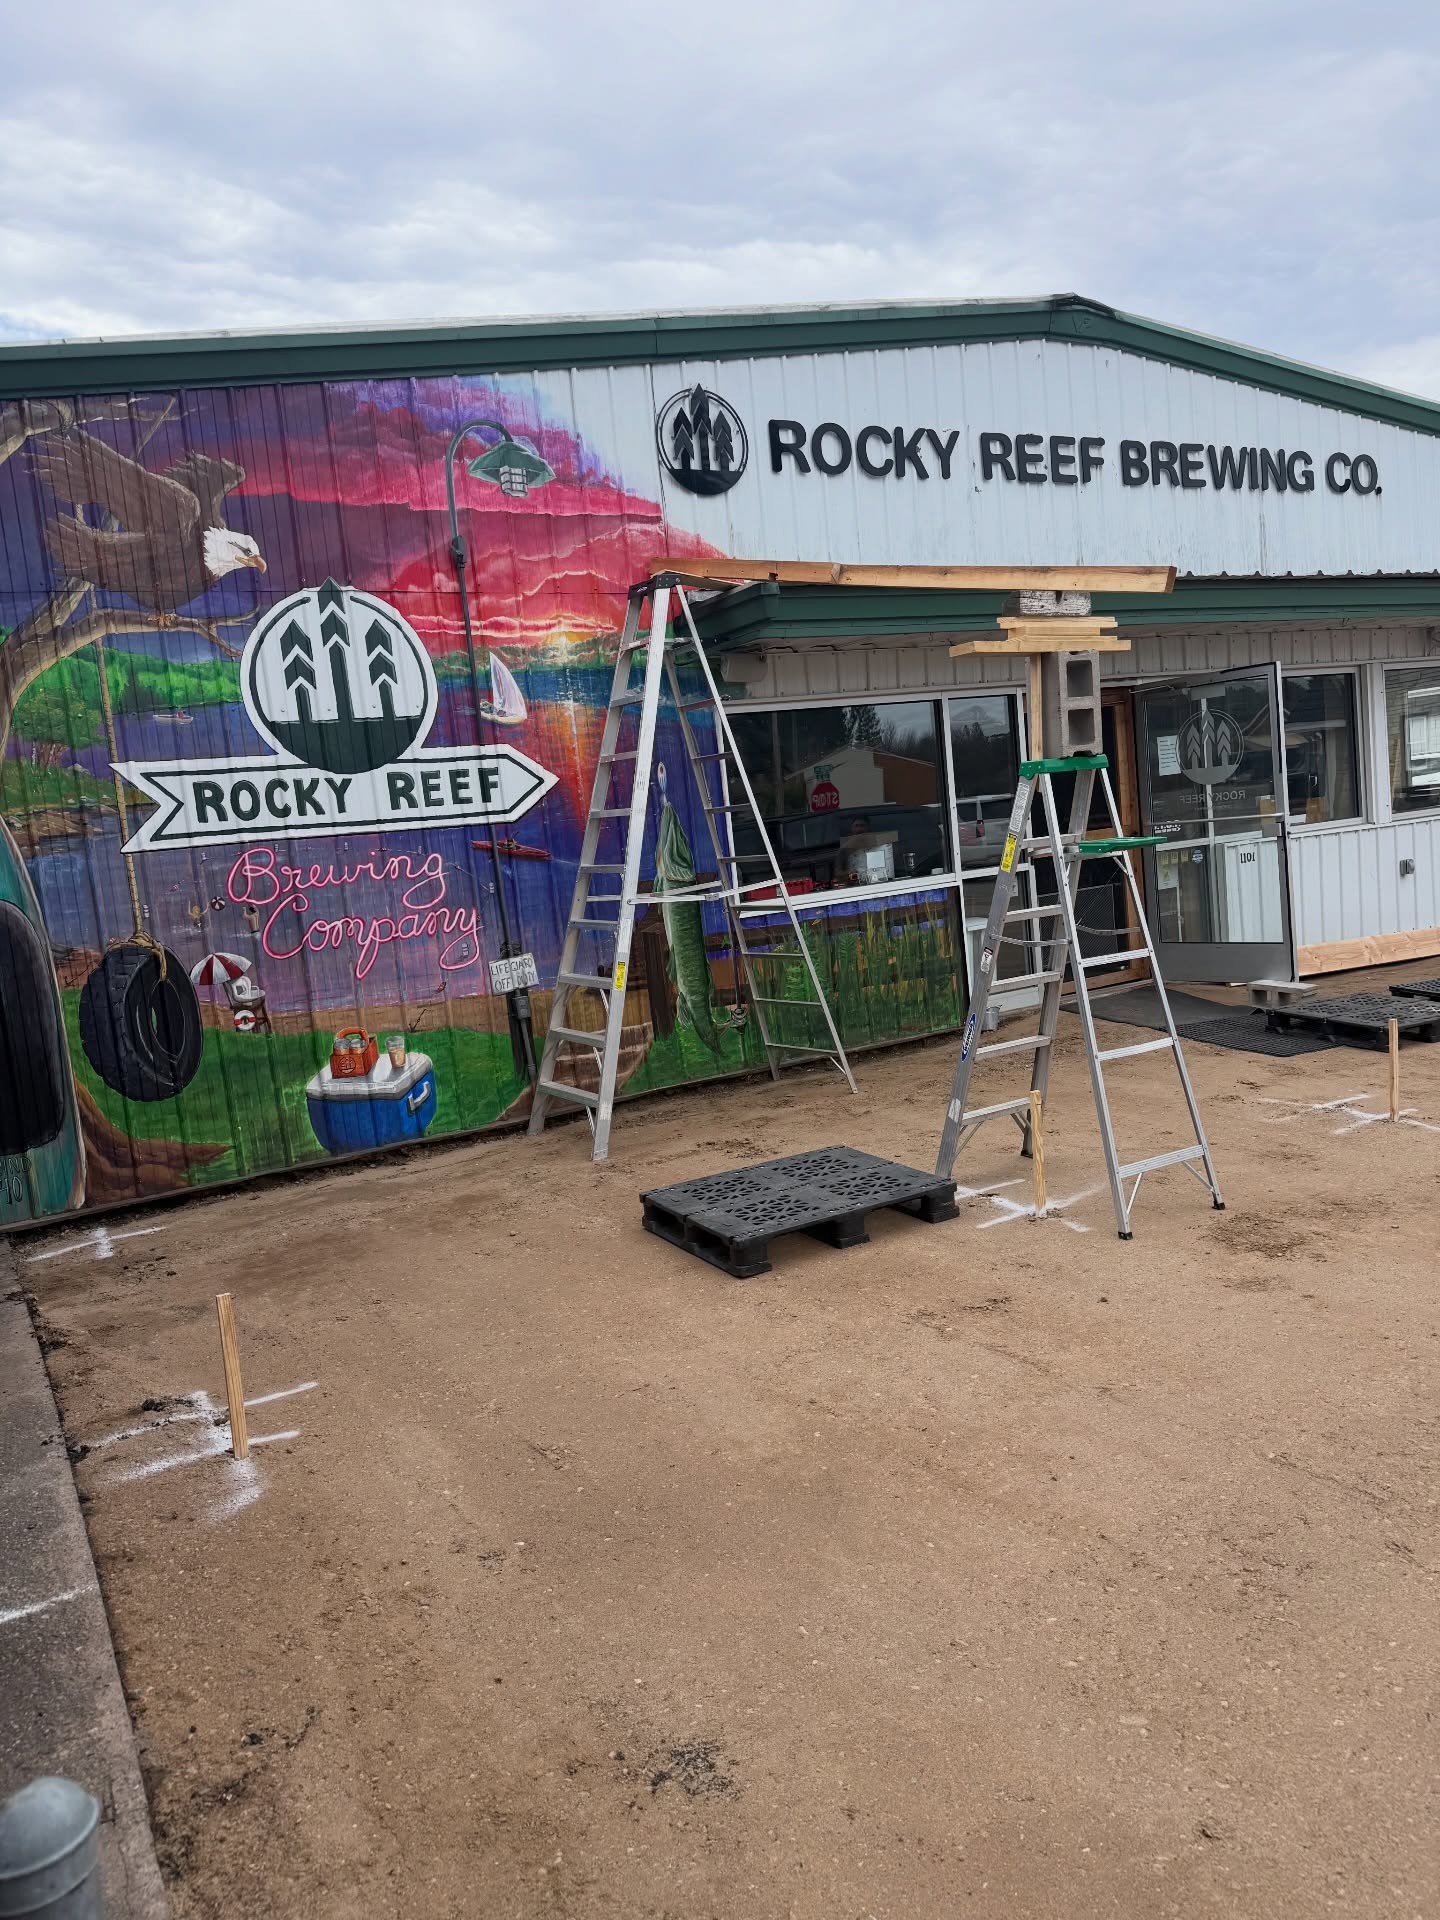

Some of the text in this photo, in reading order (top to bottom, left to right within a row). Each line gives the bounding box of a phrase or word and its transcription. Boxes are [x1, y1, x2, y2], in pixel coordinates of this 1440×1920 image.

[768, 419, 1383, 495] ROCKY REEF BREWING CO.
[192, 766, 499, 823] ROCKY REEF
[226, 847, 484, 980] Brewing Company
